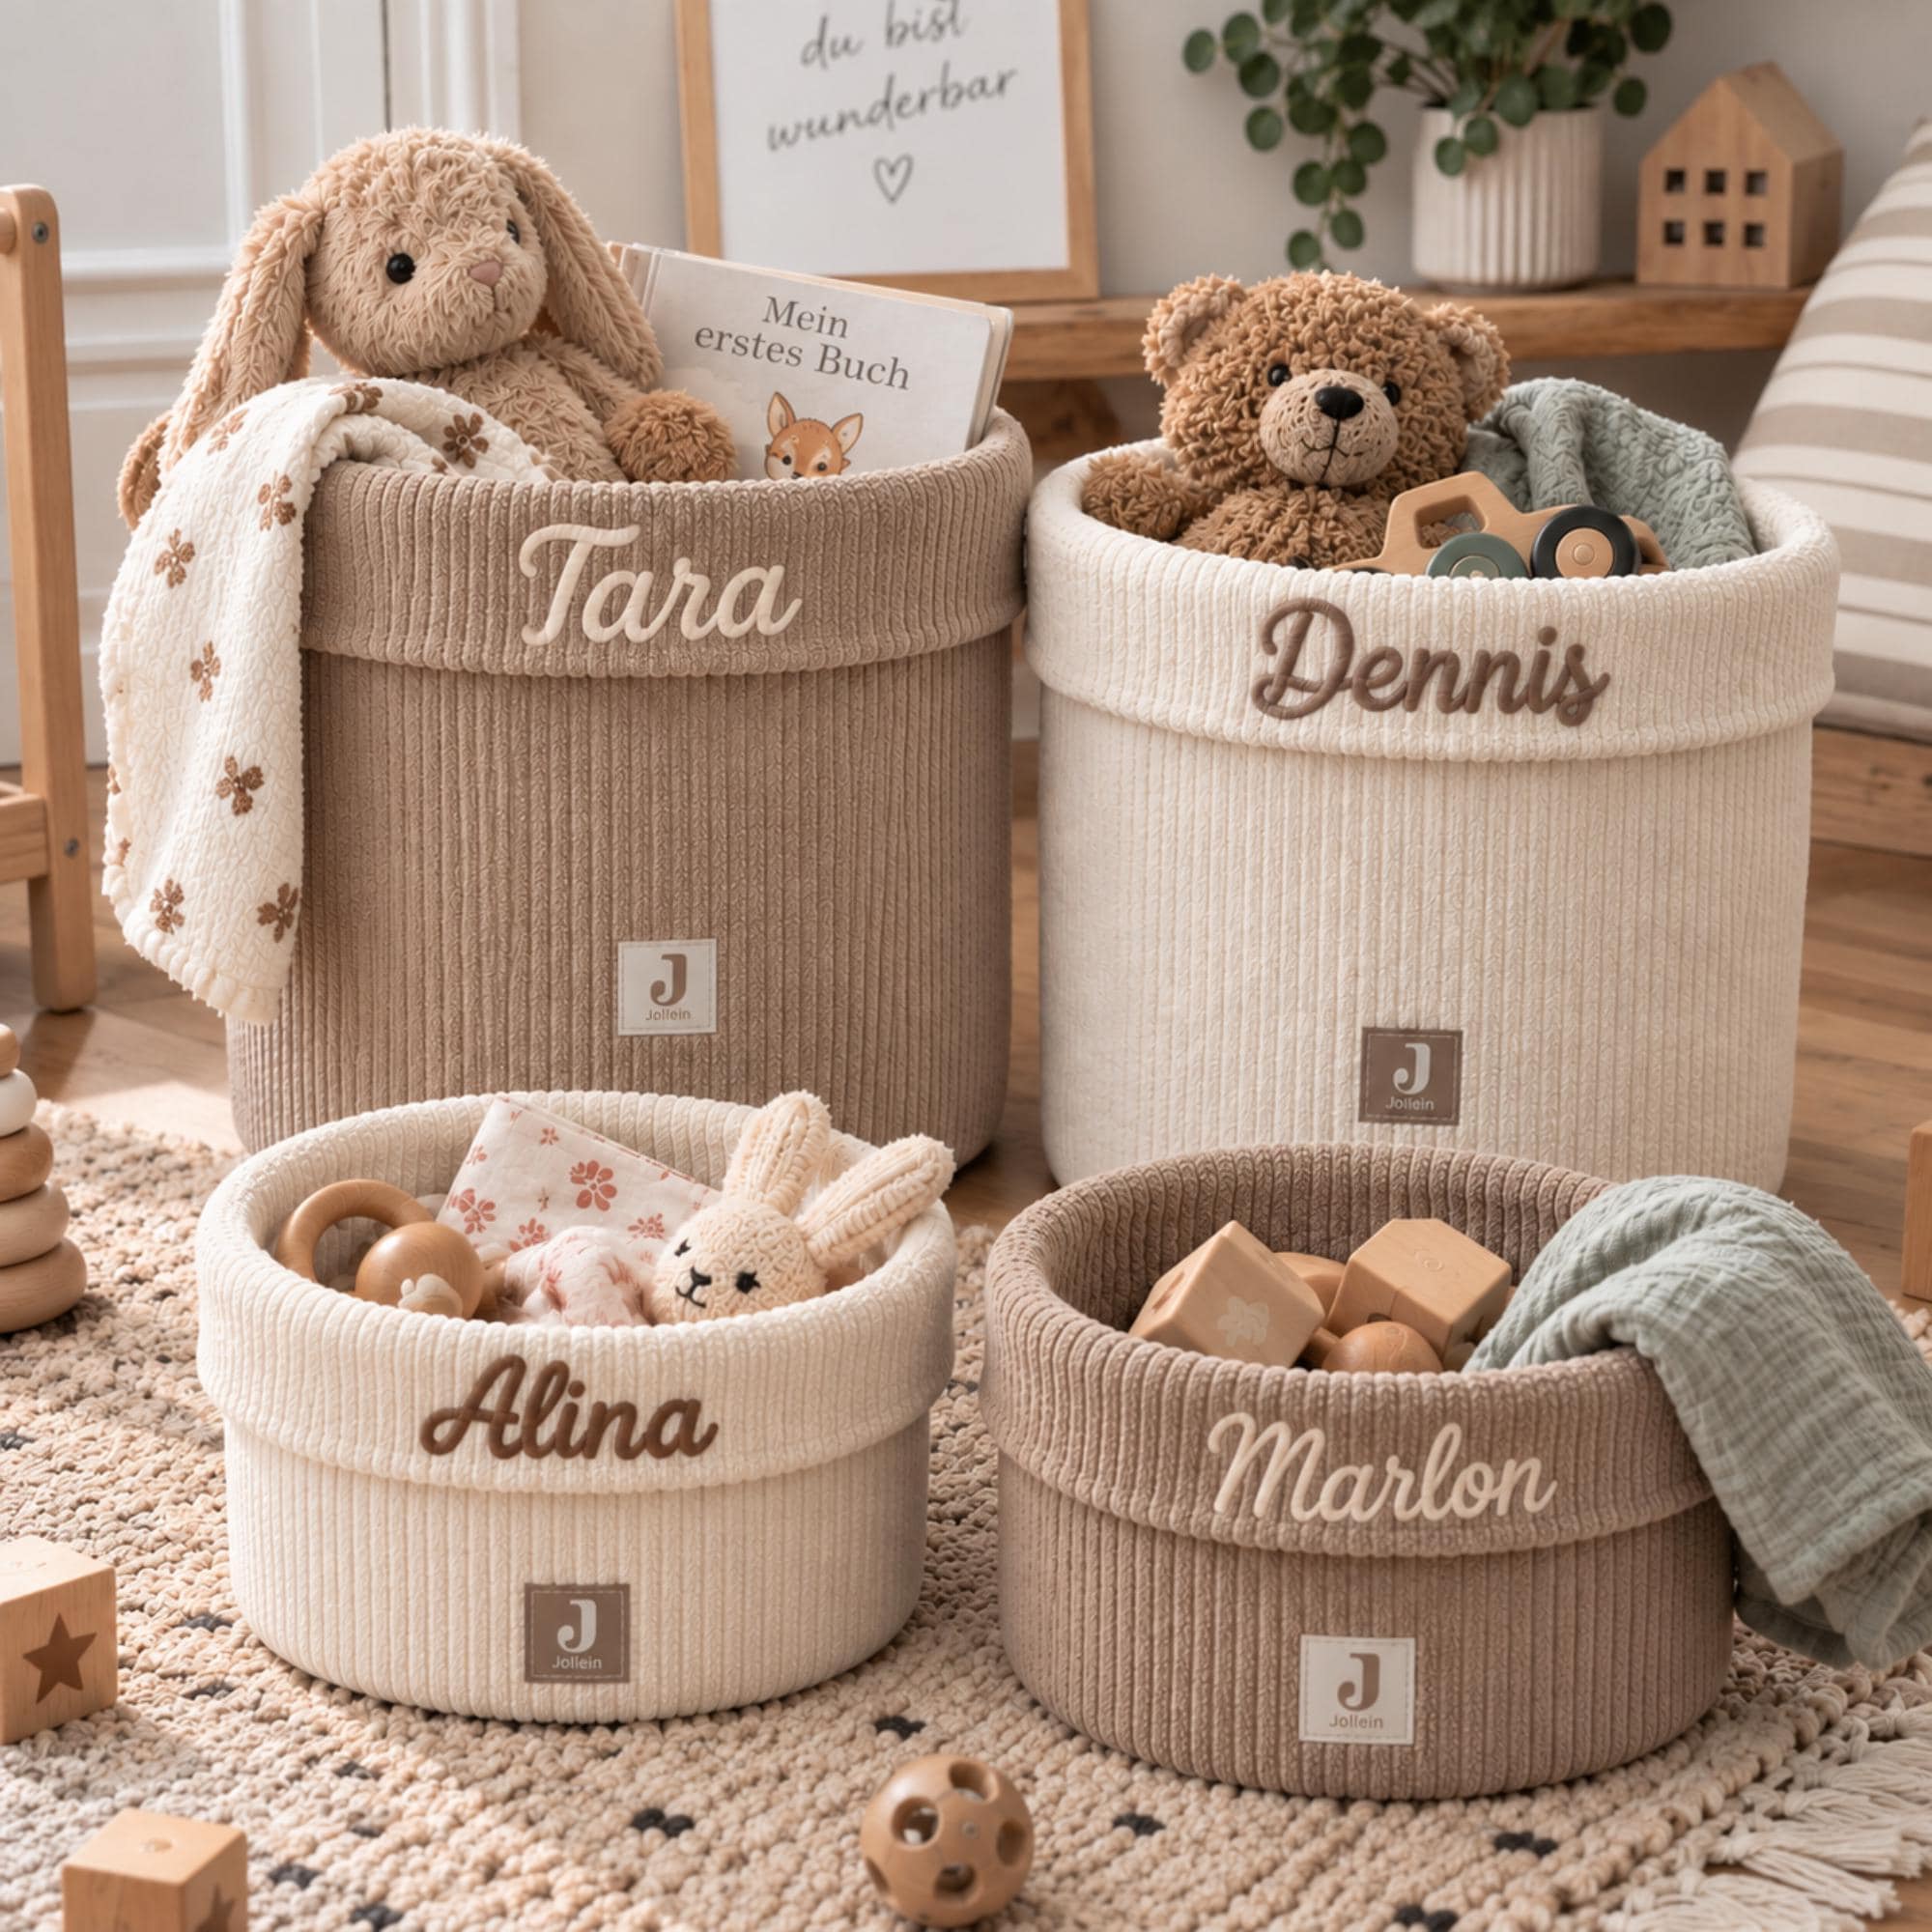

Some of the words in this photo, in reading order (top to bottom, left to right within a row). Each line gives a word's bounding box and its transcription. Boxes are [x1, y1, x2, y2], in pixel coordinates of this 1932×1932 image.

[800, 13, 866, 71] du
[885, 0, 969, 48] bist
[766, 59, 1018, 153] wunderbar
[762, 297, 849, 338] Mein
[695, 327, 803, 367] erstes
[815, 344, 909, 389] Buch
[519, 524, 803, 645] Tara
[1252, 597, 1611, 726] Dennis
[650, 953, 687, 1007] J
[1393, 1042, 1431, 1094] J
[419, 1354, 719, 1461] Alina
[1208, 1412, 1558, 1521] Marlon
[557, 1599, 597, 1654] J
[1337, 1653, 1380, 1712] J
[1329, 1715, 1383, 1729] Jollein
